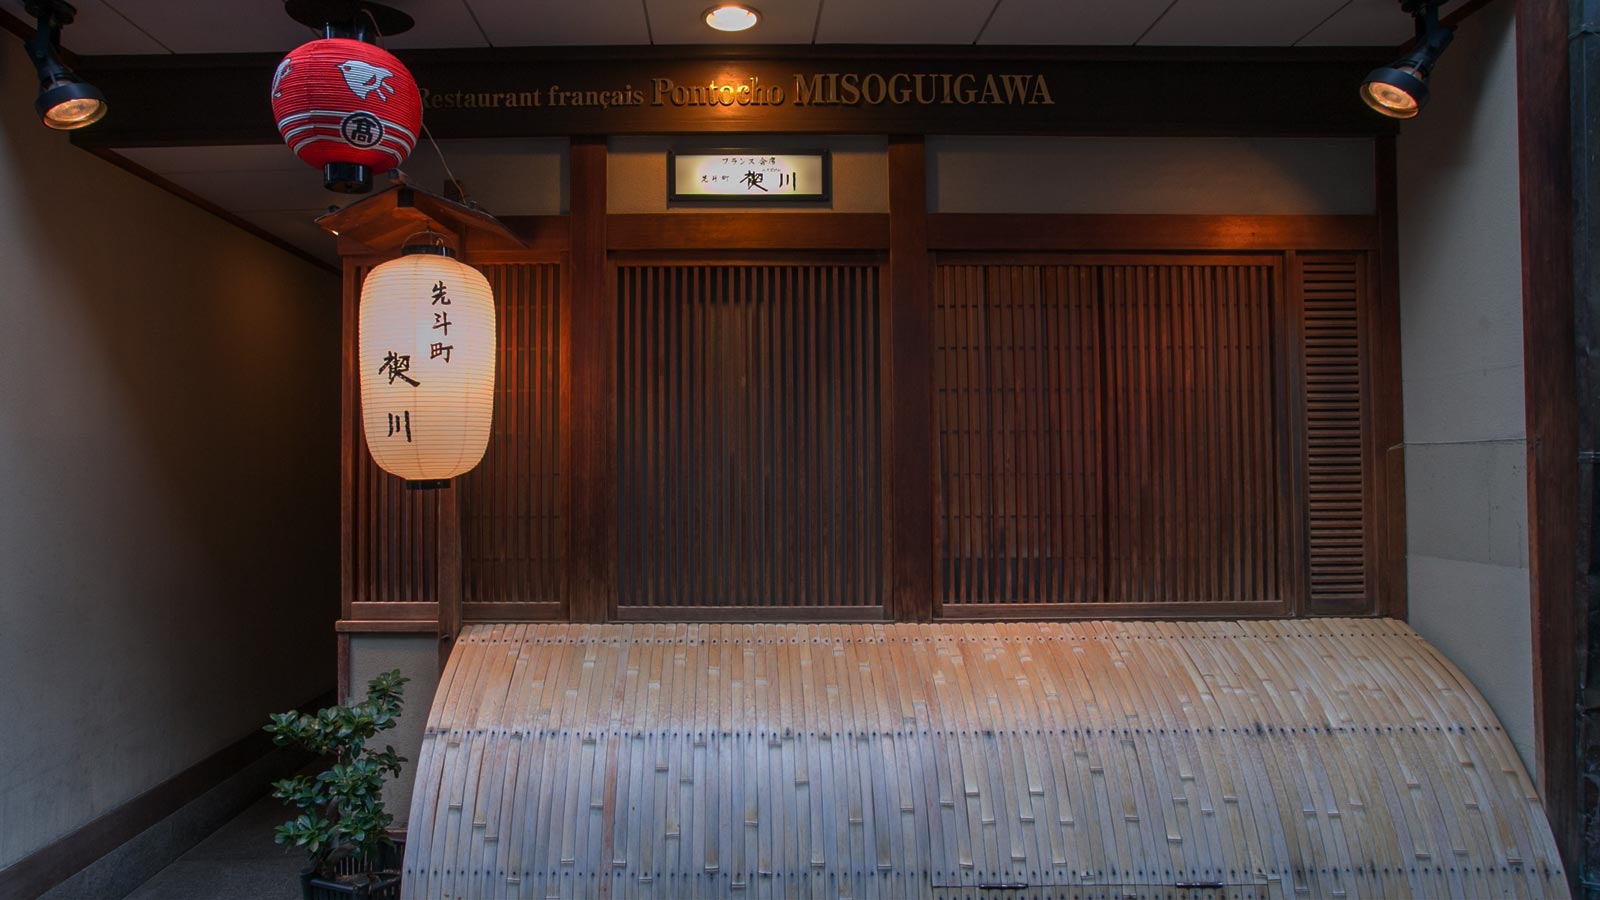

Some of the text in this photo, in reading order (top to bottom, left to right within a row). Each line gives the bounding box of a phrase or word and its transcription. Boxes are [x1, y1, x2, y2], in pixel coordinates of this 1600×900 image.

[420, 73, 1055, 111] Restaurant français Pontocho MISOGUIGAWA
[430, 280, 453, 363] 先斗町
